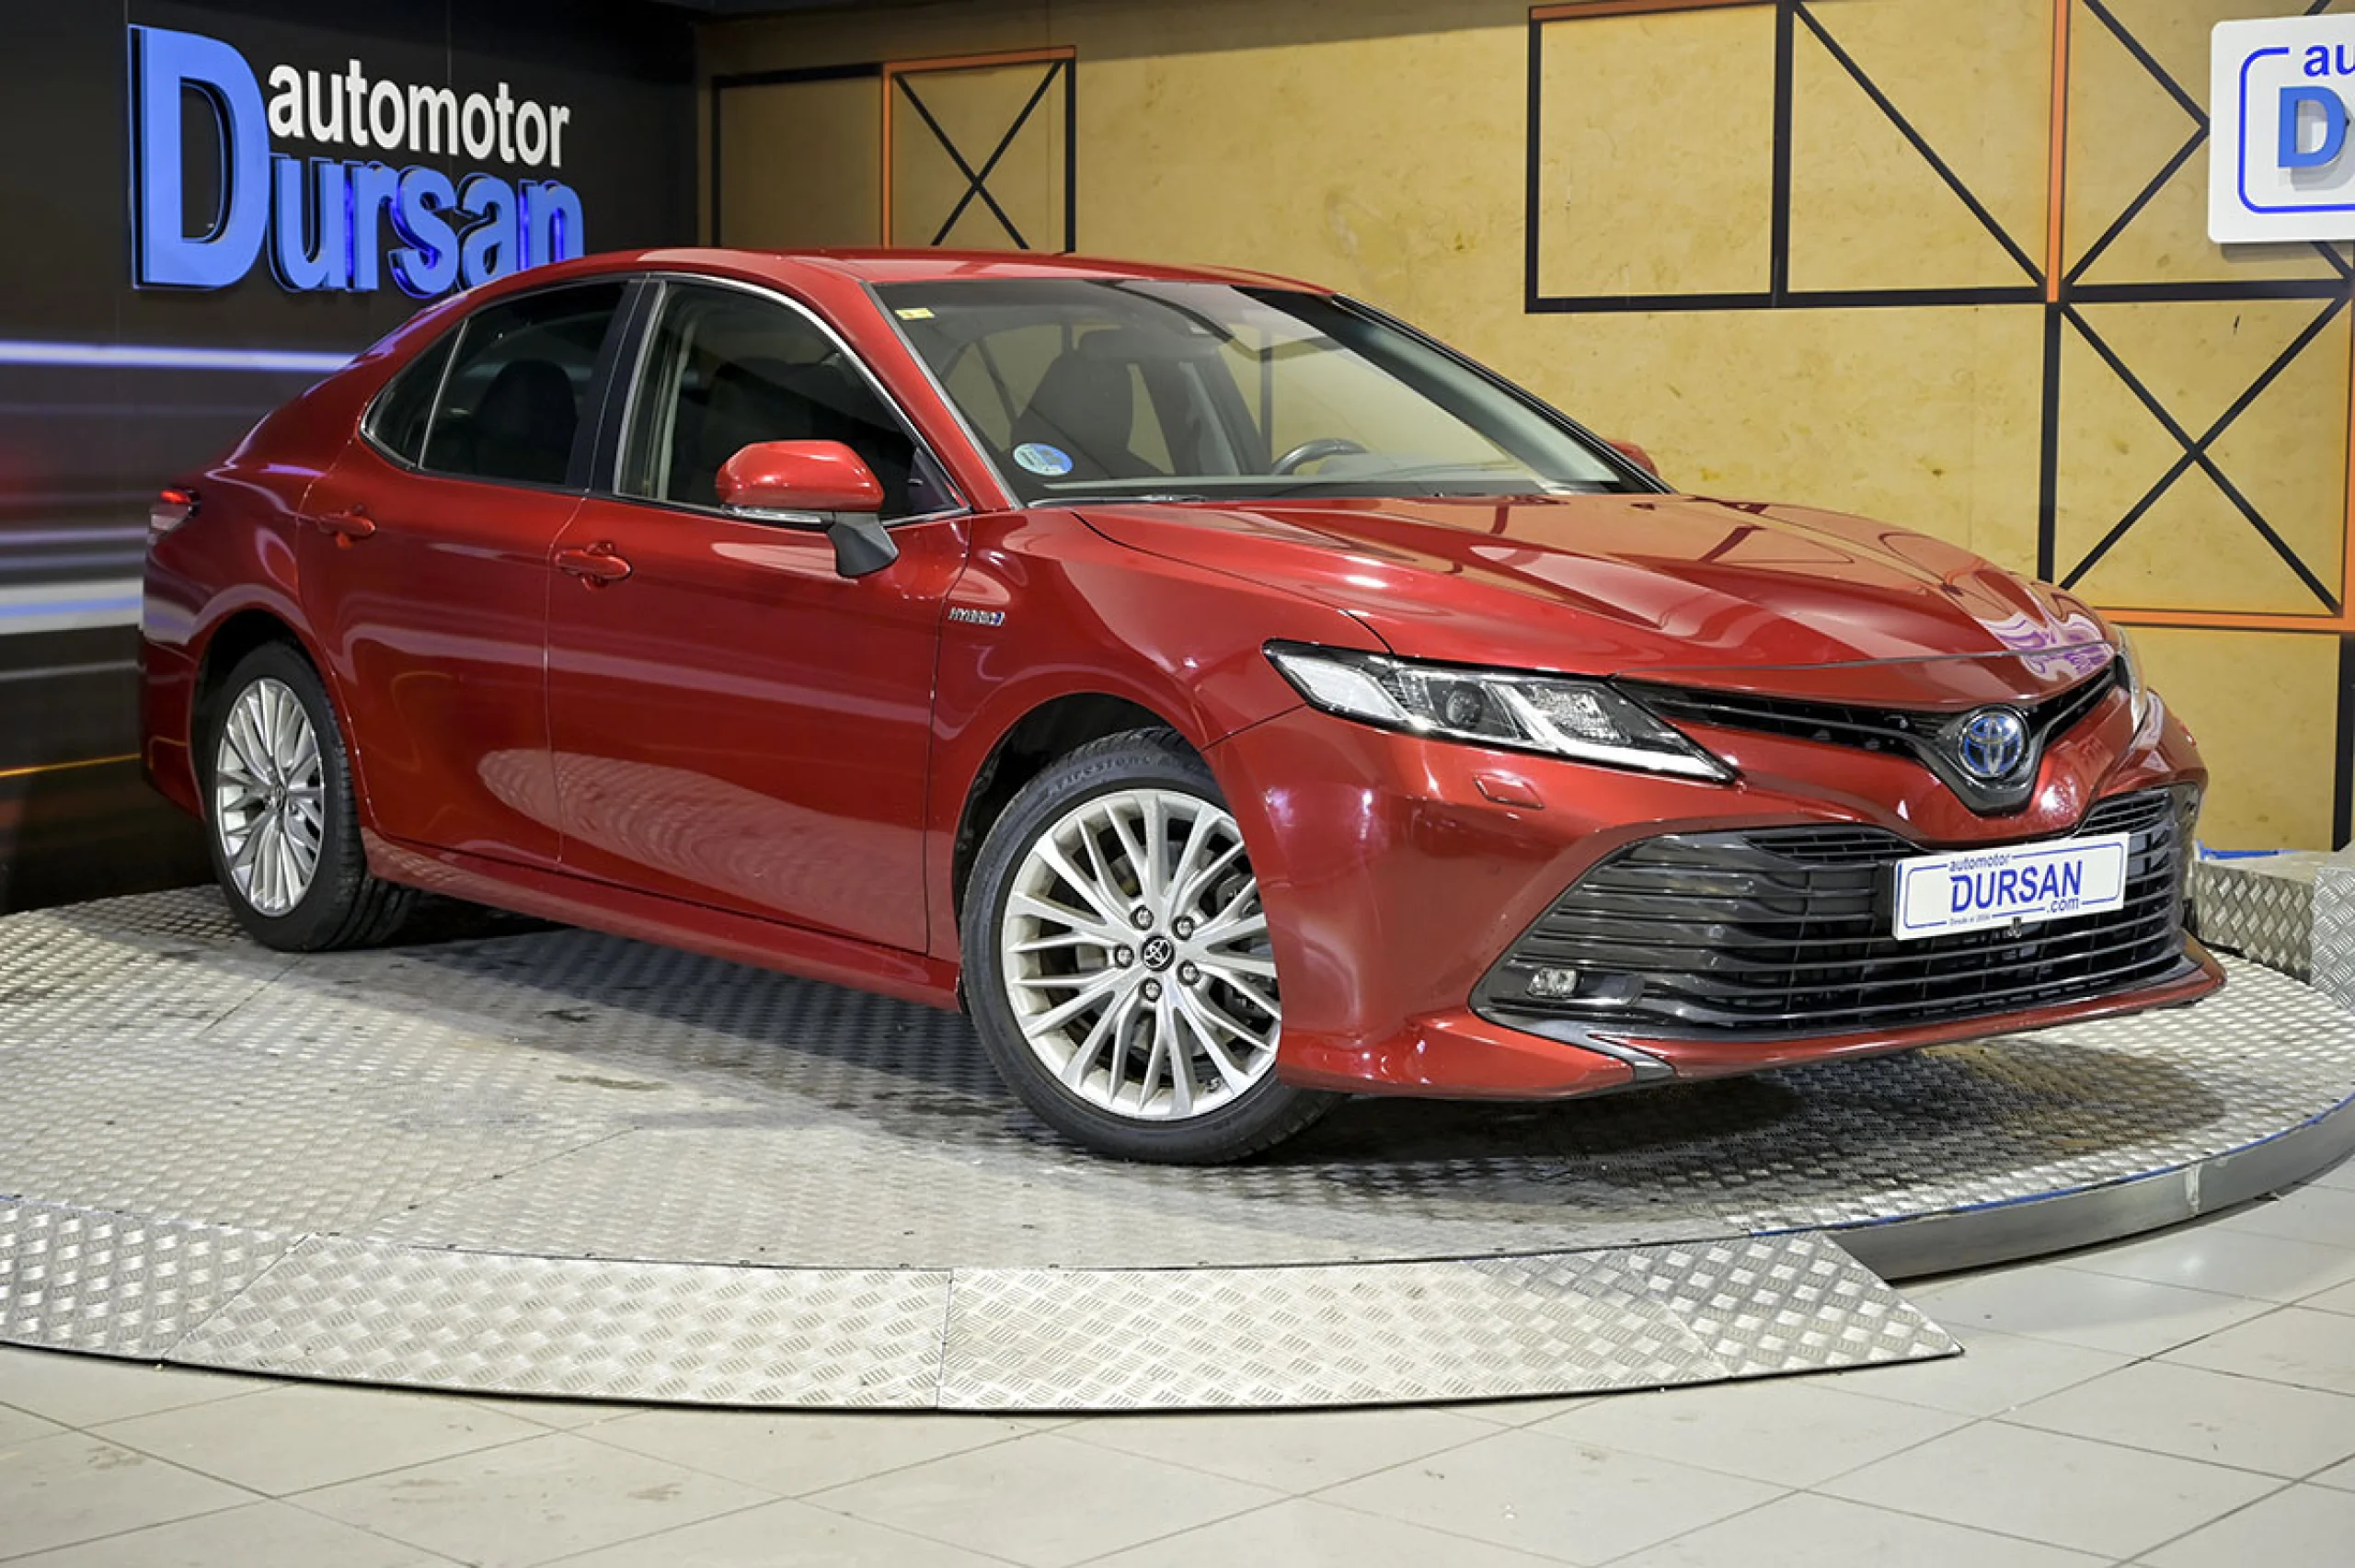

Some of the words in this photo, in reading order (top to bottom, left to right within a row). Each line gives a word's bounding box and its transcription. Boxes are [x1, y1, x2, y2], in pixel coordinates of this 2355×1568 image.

[269, 59, 570, 167] automotor
[2278, 86, 2348, 167] D
[128, 24, 584, 299] Dursan
[1949, 853, 2011, 872] automotor
[1949, 861, 2082, 913] DURSAN
